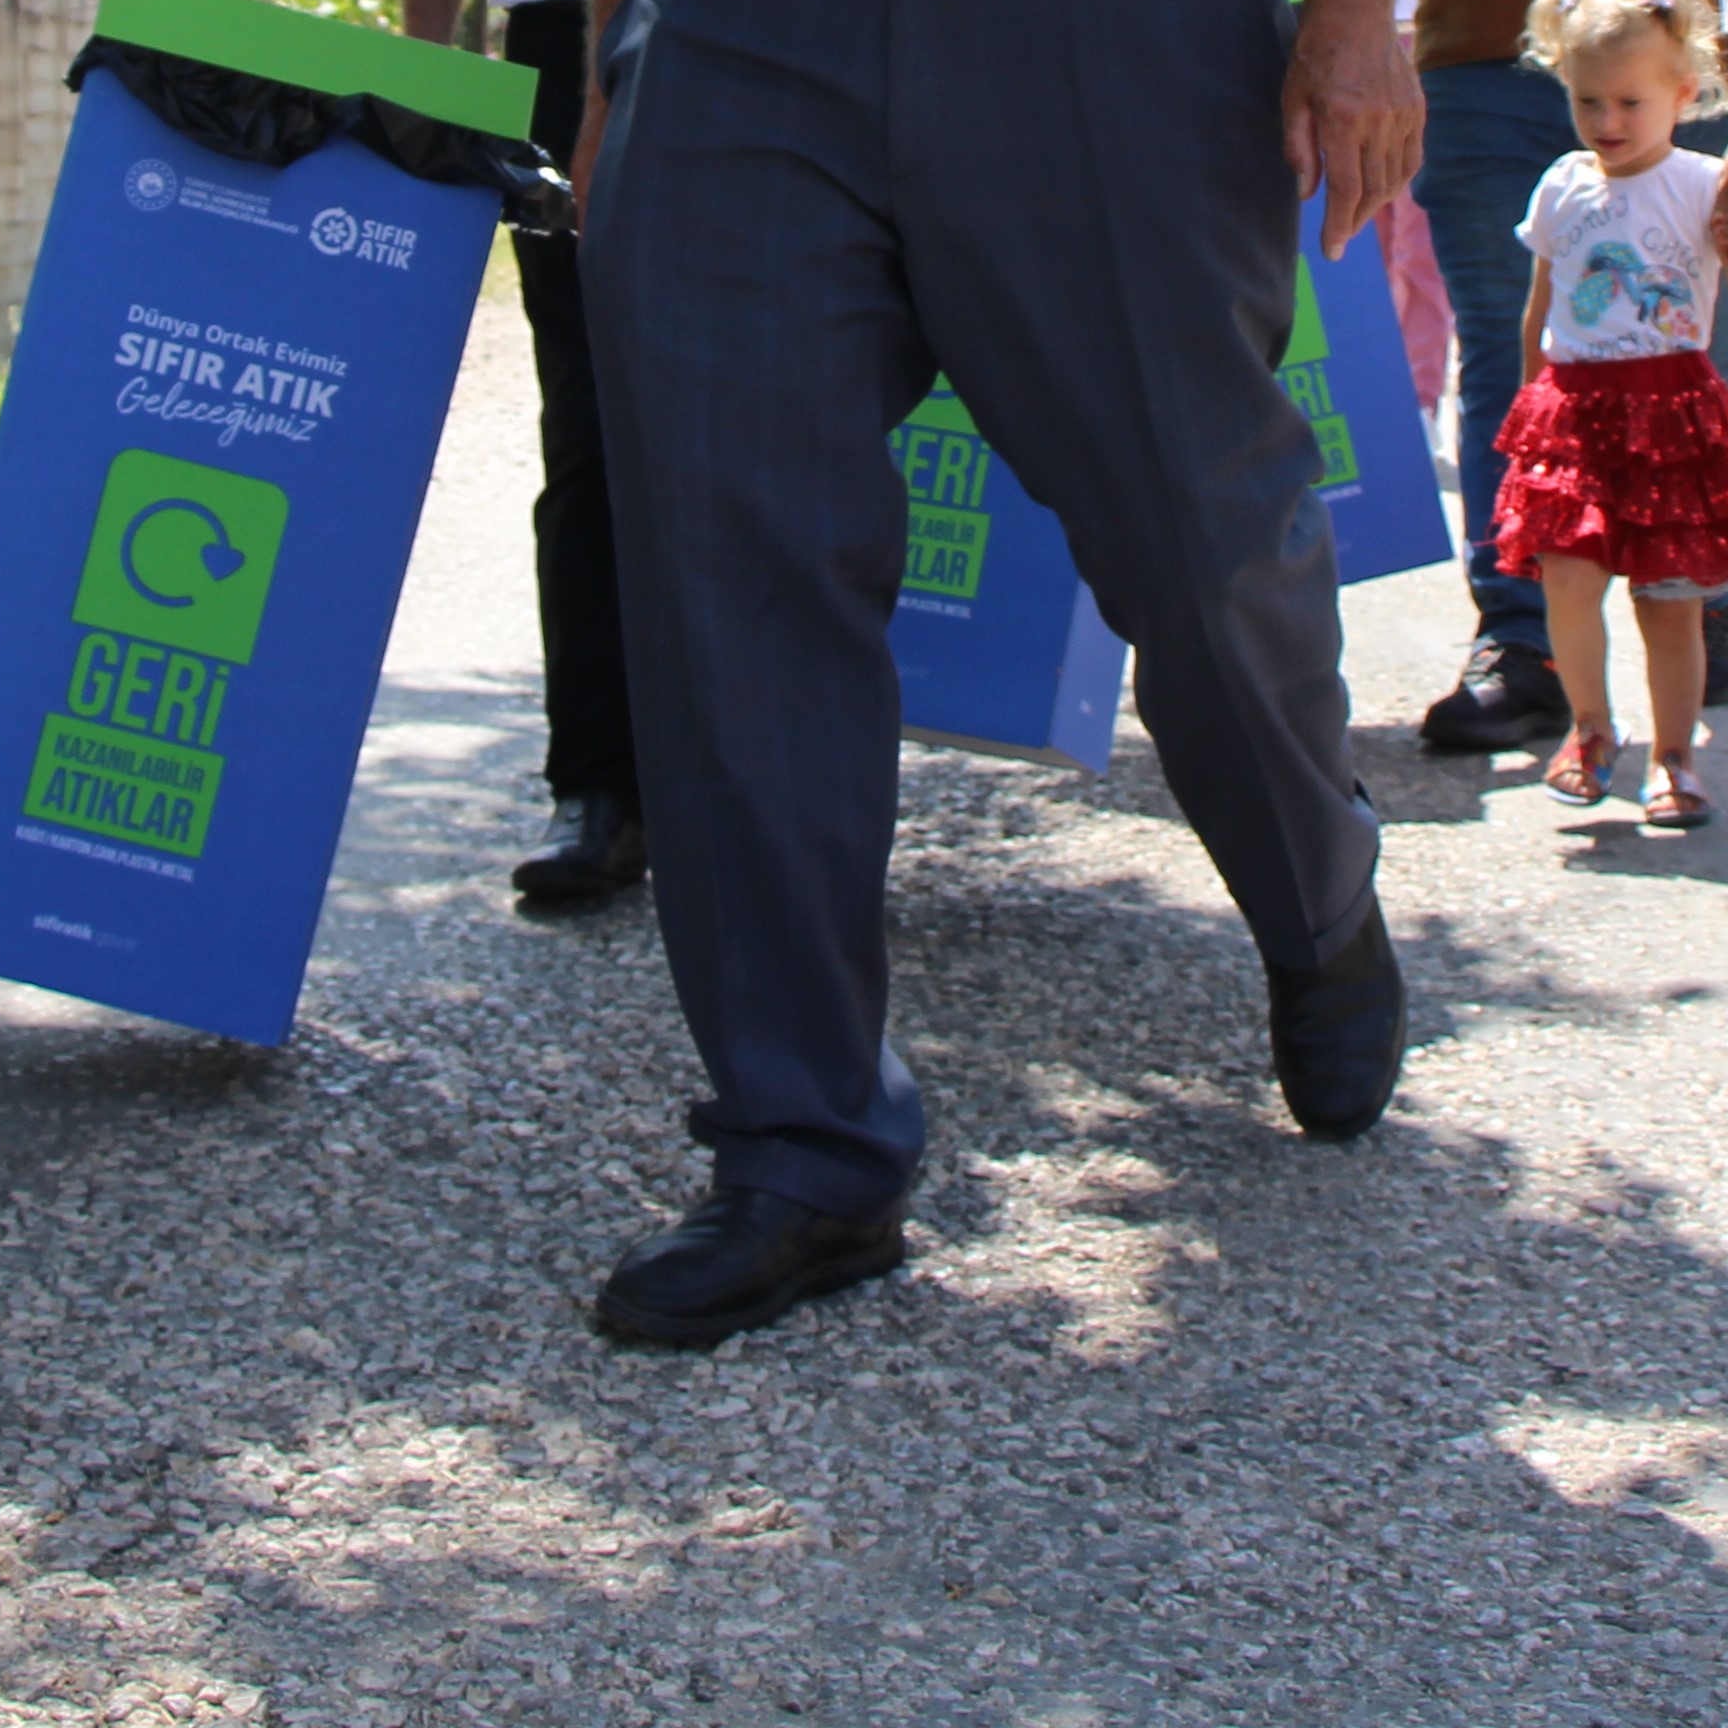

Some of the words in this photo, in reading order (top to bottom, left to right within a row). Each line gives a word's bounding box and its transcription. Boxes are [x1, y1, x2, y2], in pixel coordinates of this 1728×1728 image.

[355, 239, 413, 271] ATIK
[360, 219, 419, 249] SIFIR
[114, 332, 225, 390] SIFIR
[231, 363, 341, 418] ATIK
[127, 304, 200, 338] Dünya
[205, 325, 272, 357] Ortak
[274, 342, 348, 377] Evimiz
[116, 376, 317, 447] Geleceğimiz
[67, 631, 230, 747] GERİ
[40, 766, 195, 843] ATIKLAR
